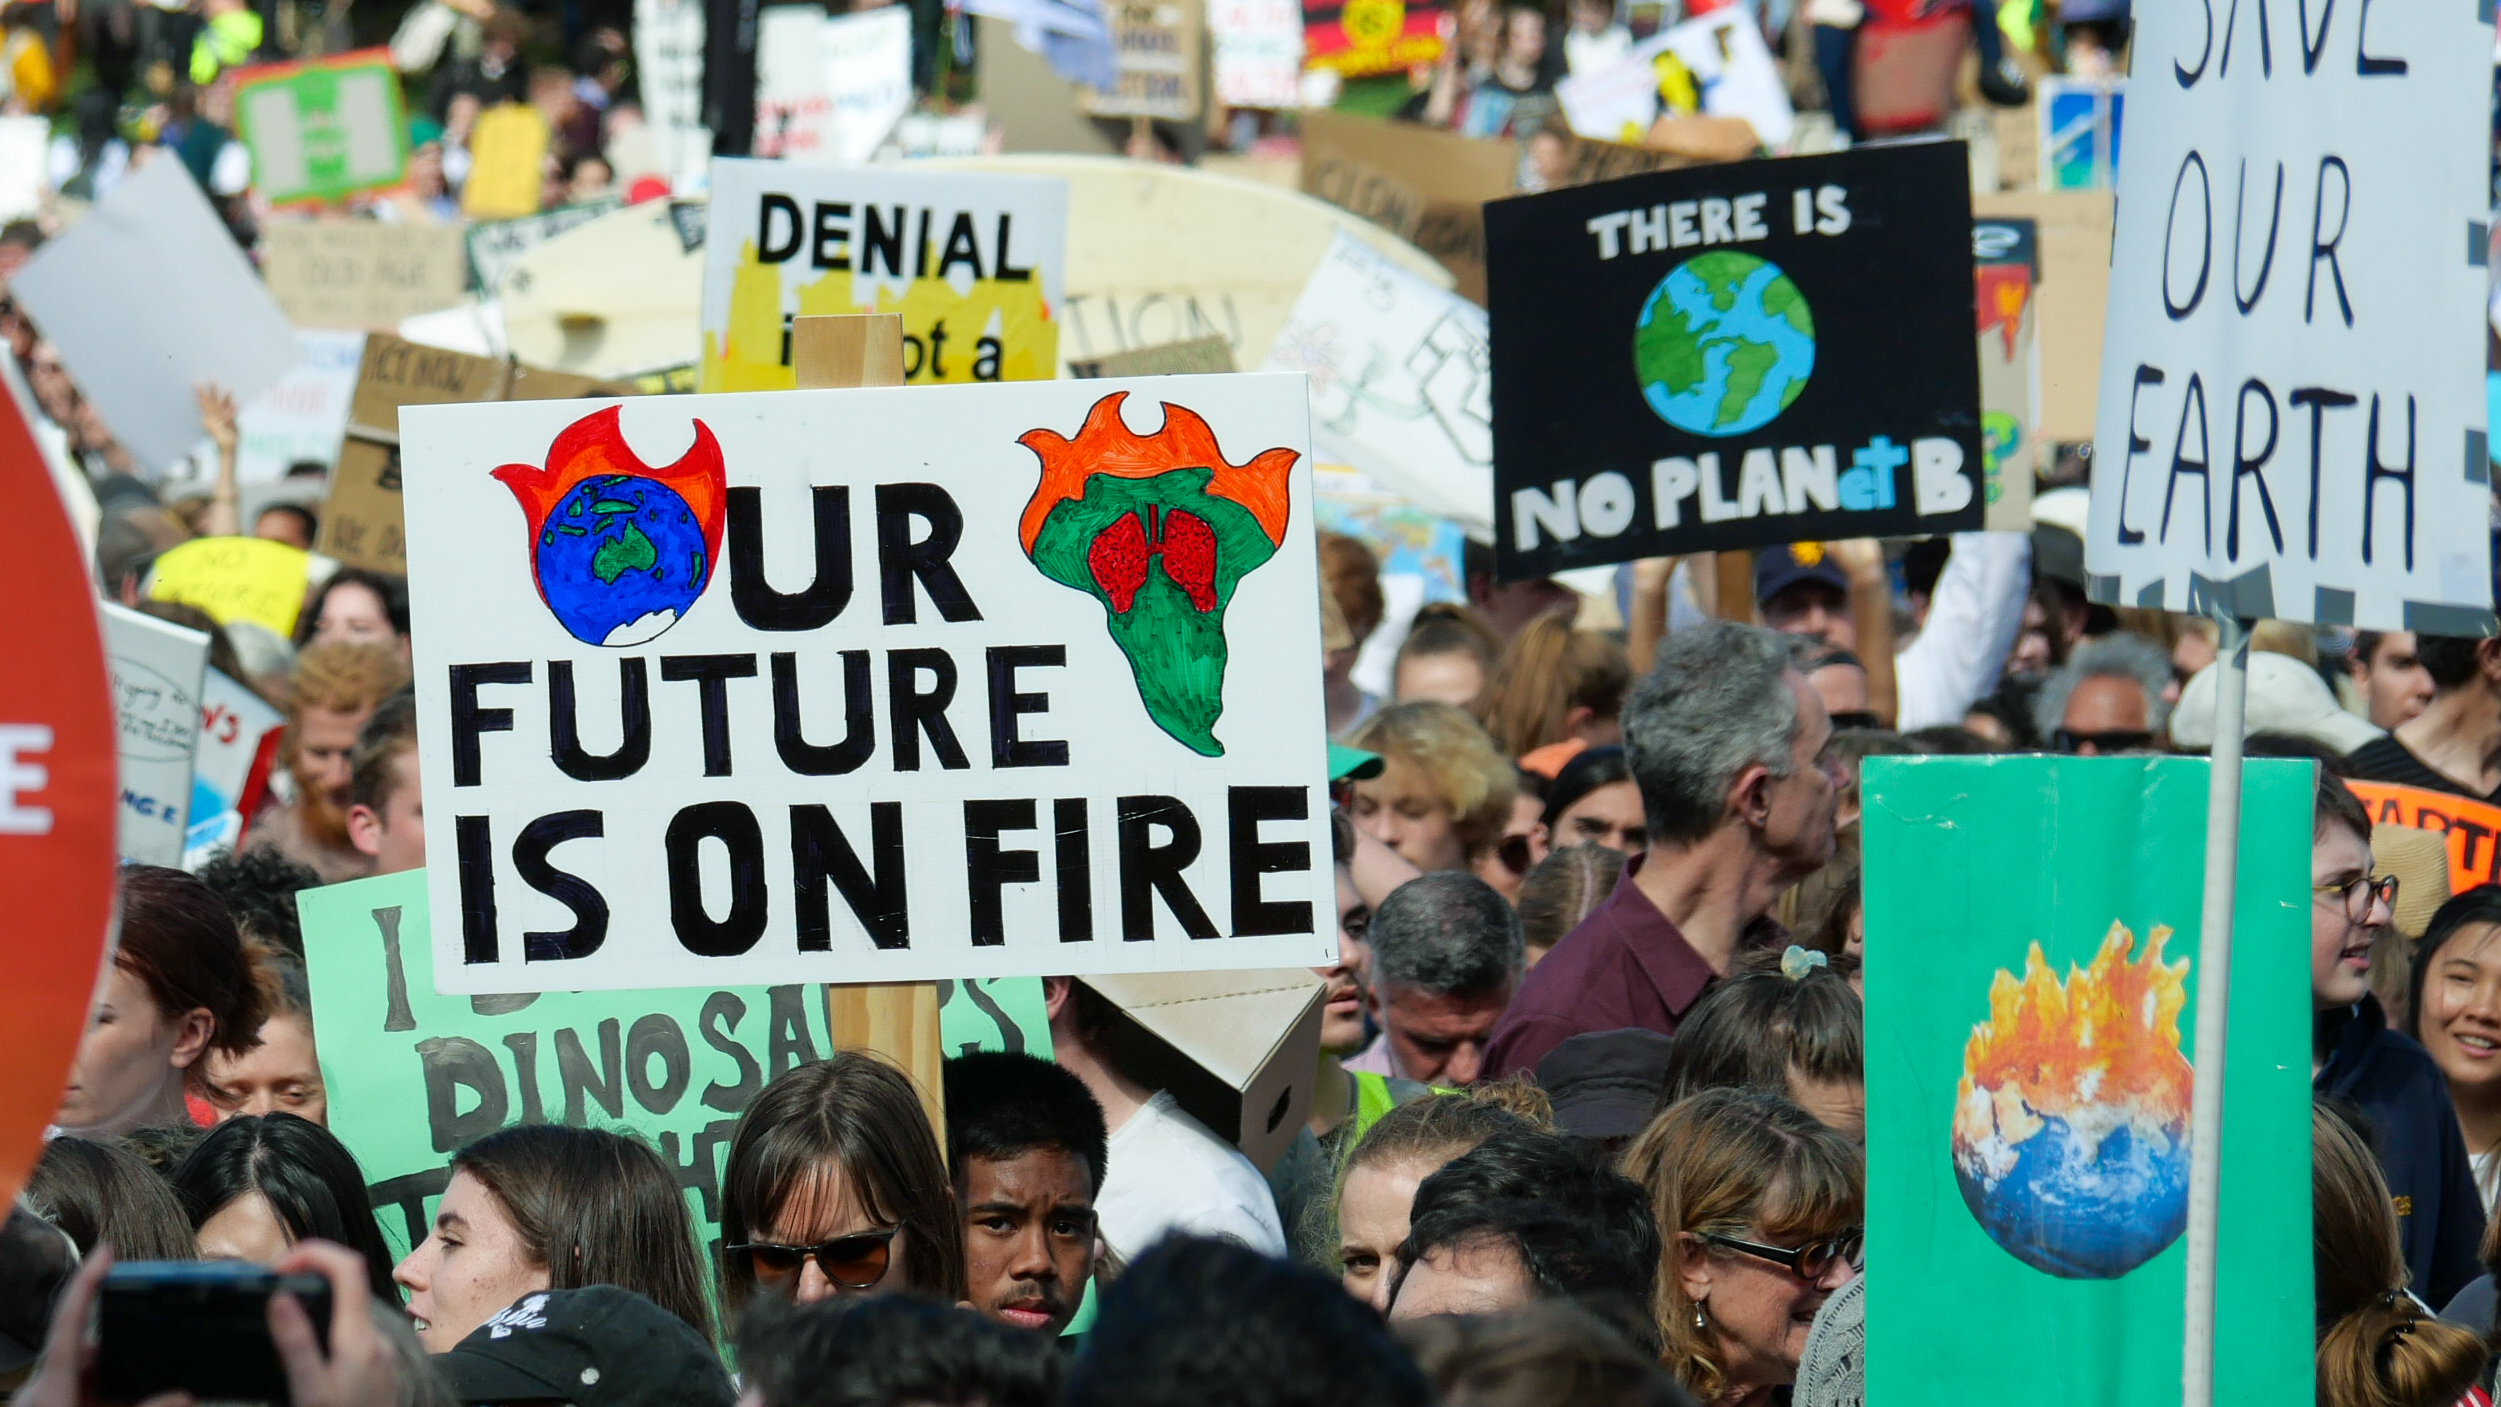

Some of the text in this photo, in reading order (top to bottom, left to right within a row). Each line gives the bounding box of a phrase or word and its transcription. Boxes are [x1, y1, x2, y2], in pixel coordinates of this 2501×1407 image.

[757, 191, 1031, 280] DENIAL
[1586, 185, 1852, 260] THERE IS
[2163, 149, 2354, 328] OUR
[903, 318, 949, 380] ot
[973, 335, 1004, 381] a
[1511, 471, 1636, 553] NO
[1910, 436, 1974, 517] B
[2117, 363, 2416, 574] EARTH
[449, 644, 1071, 788] FUTURE
[455, 785, 1315, 966] IS ON FIRE
[371, 905, 417, 1032] I
